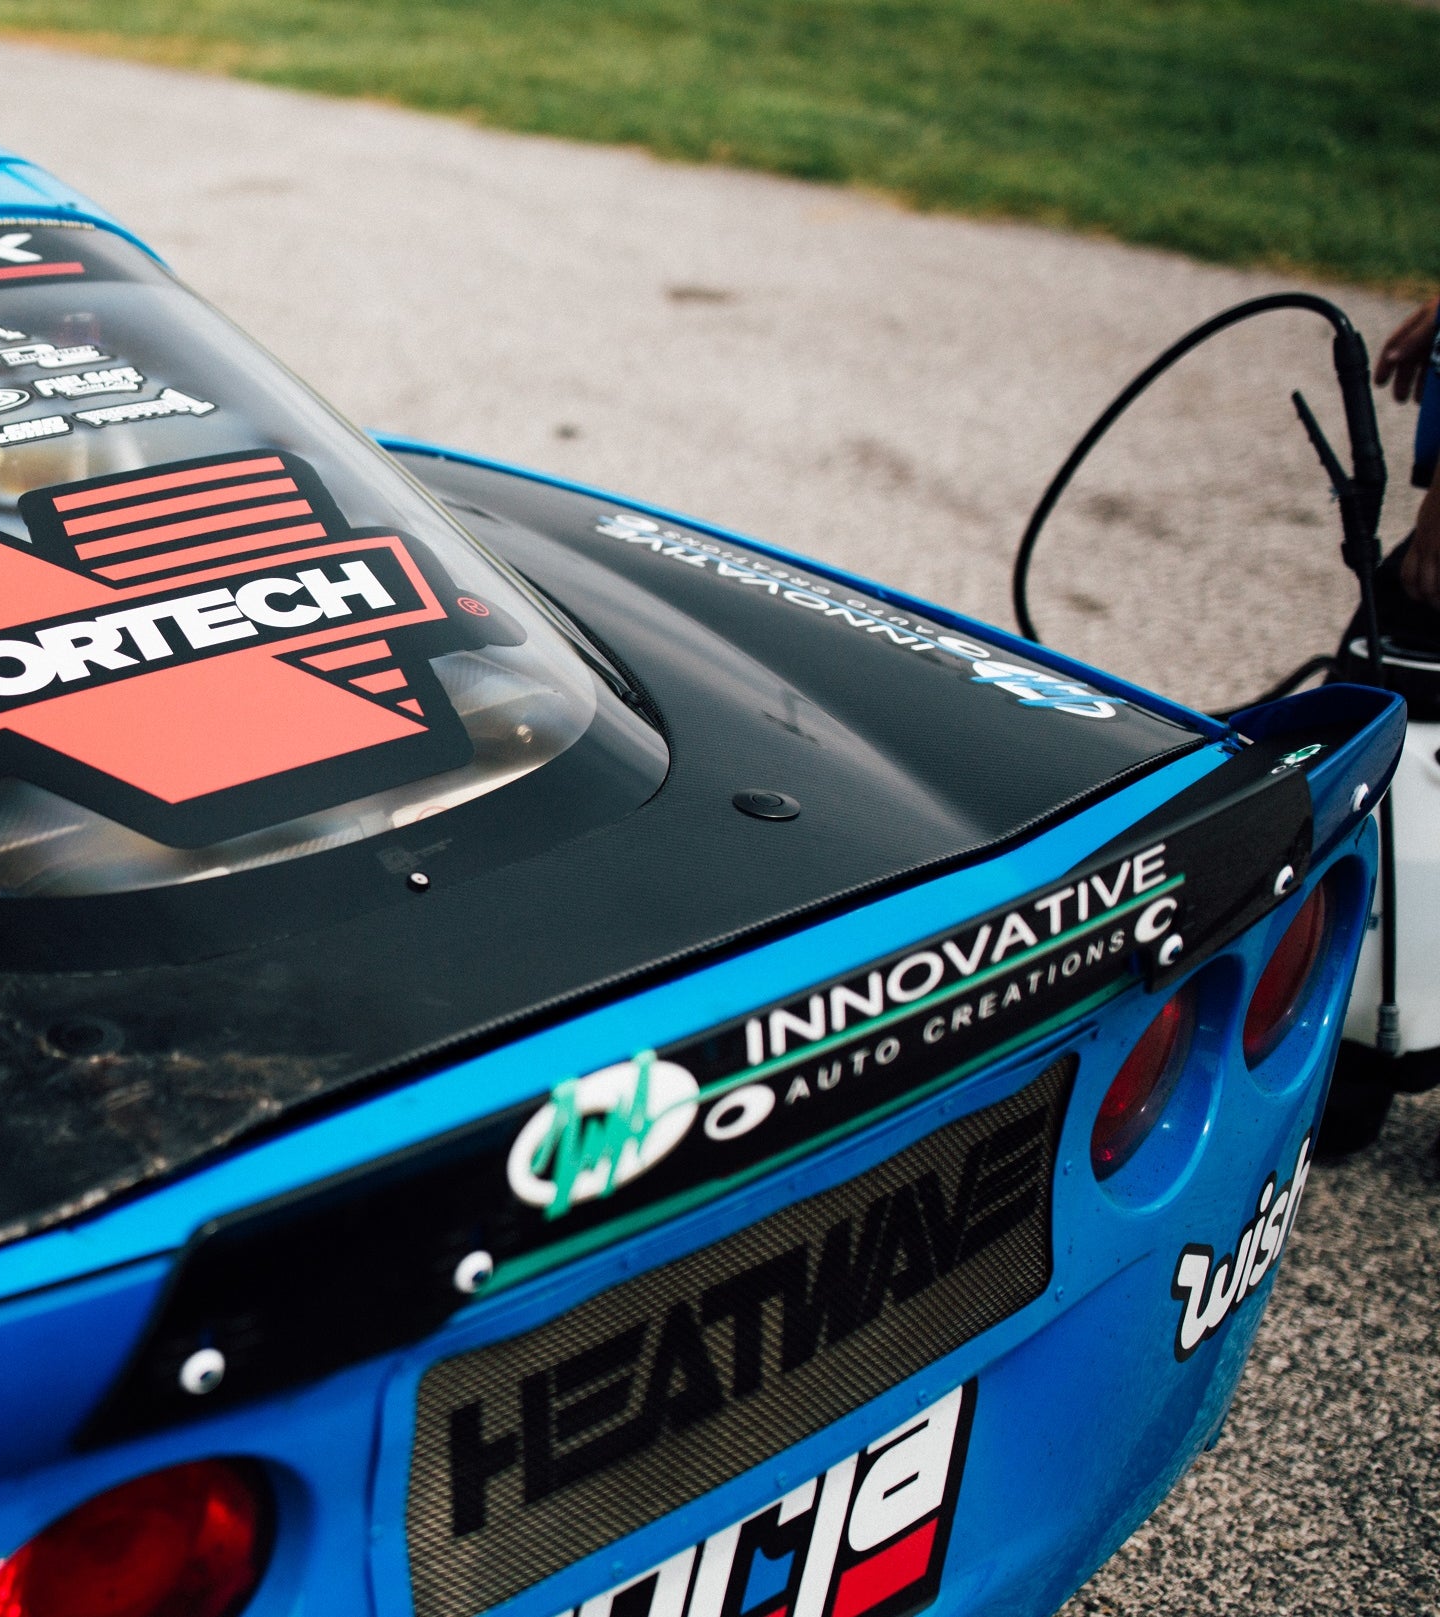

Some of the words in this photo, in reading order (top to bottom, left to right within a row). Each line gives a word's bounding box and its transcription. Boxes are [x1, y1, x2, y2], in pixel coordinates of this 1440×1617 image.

[595, 522, 936, 652] INNOVATIVE
[745, 843, 1166, 1066] INNOVATIVE
[785, 1037, 901, 1106] AUTO
[922, 930, 1126, 1046] CREATIONS
[452, 1103, 1052, 1538] HEATWAVE
[1176, 1136, 1312, 1351] wish
